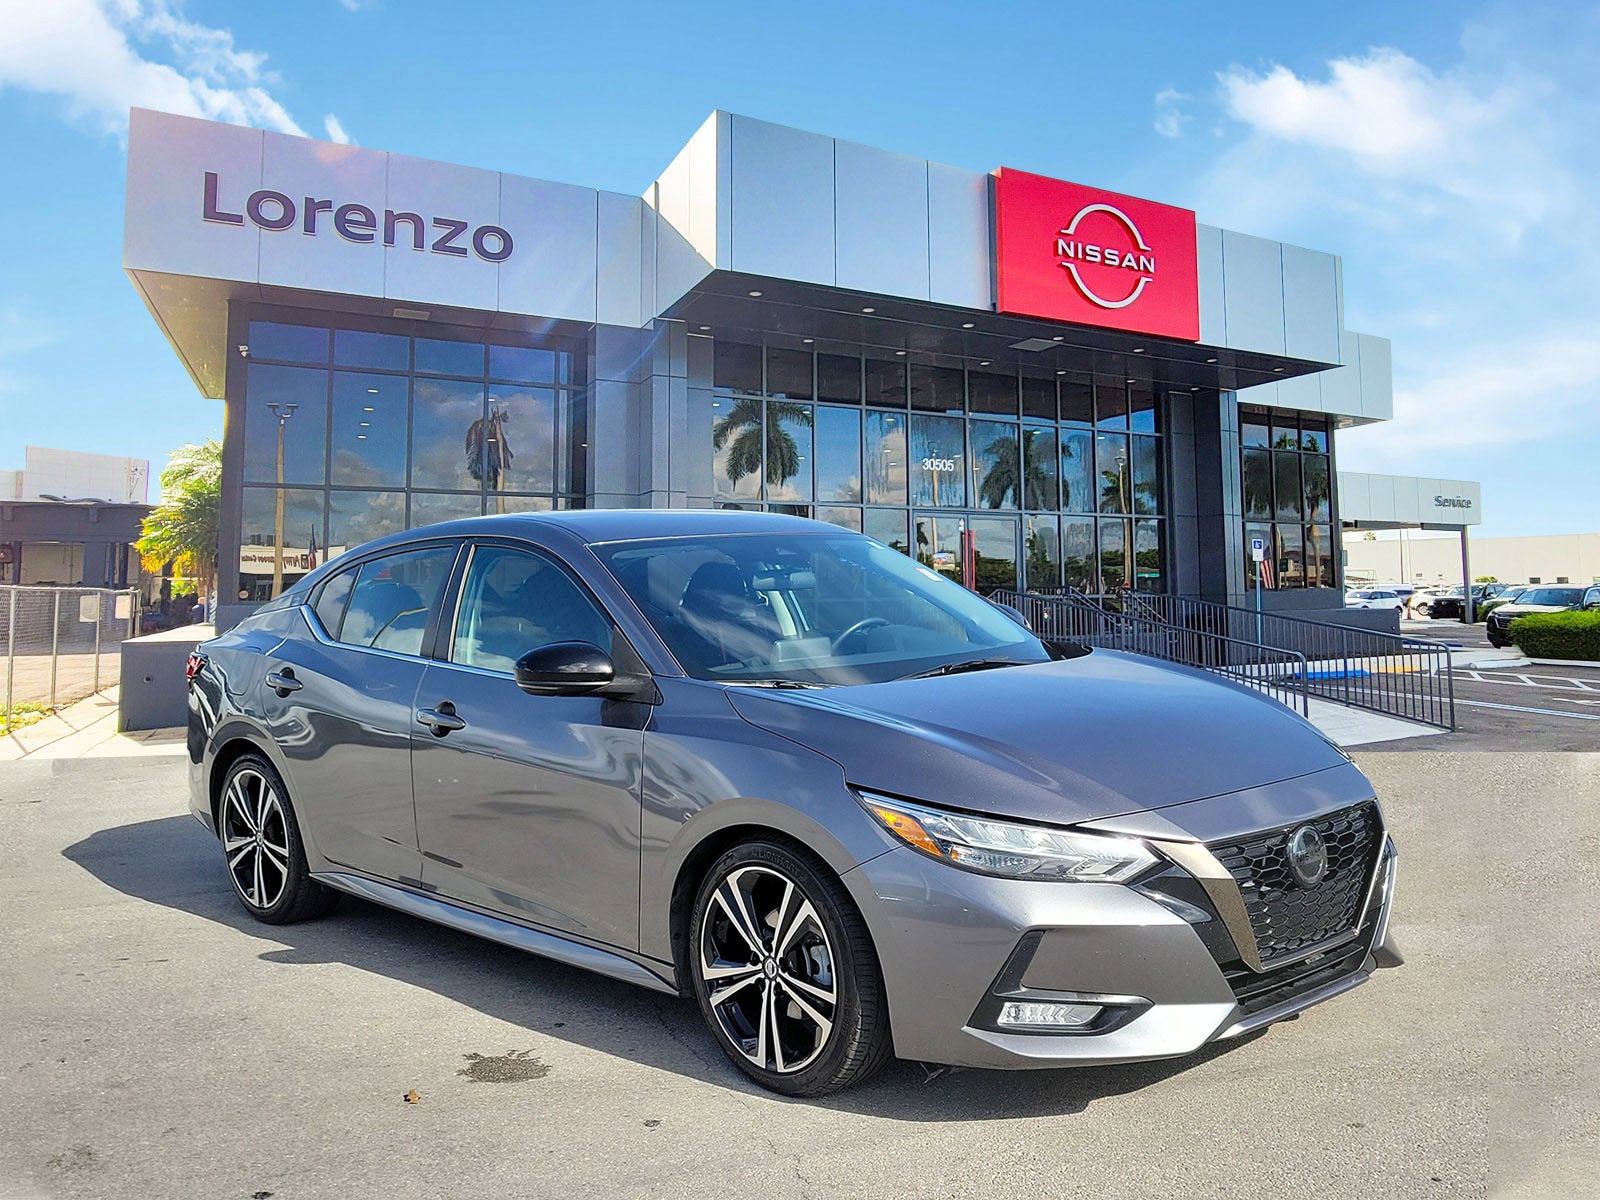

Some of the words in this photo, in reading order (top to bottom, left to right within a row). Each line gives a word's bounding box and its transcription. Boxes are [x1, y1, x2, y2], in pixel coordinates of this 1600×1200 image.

[202, 171, 514, 262] Lorenzo
[1057, 238, 1155, 273] NISSAN
[922, 458, 954, 471] 30505
[1434, 495, 1472, 508] Service
